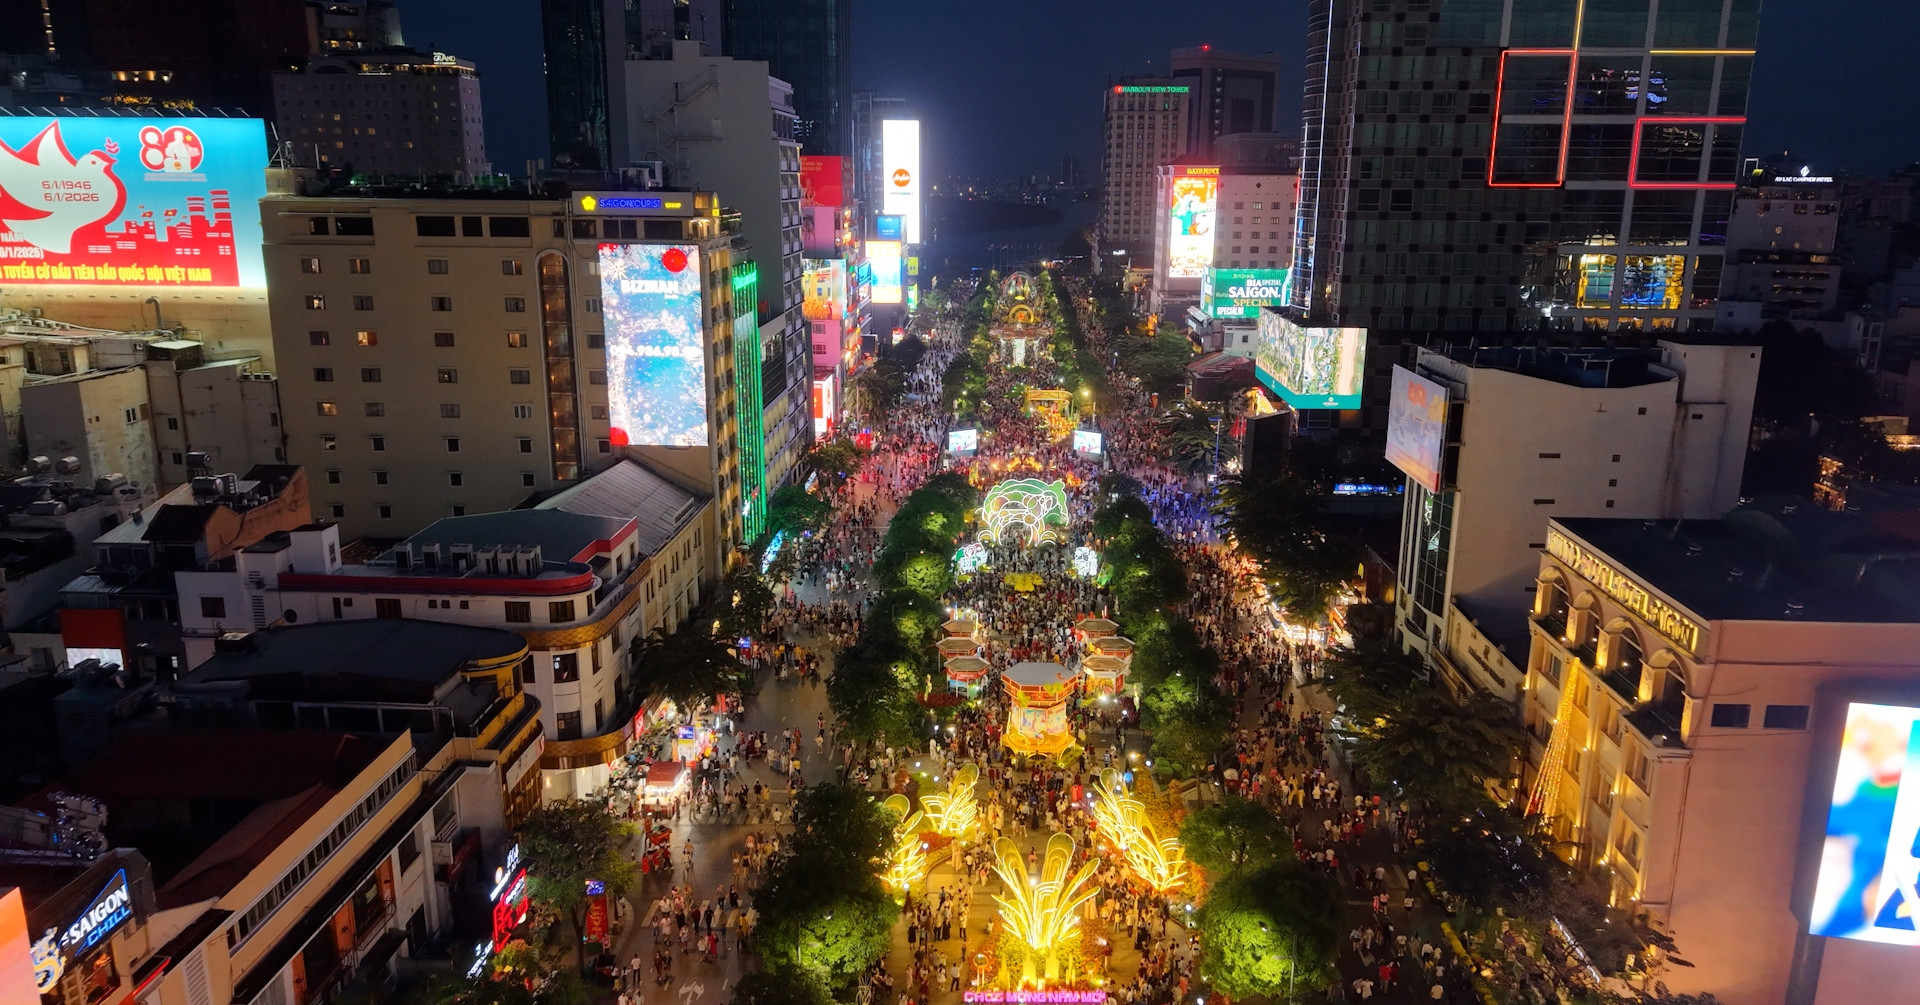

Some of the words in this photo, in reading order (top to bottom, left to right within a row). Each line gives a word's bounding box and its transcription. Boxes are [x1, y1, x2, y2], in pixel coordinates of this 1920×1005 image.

[42, 180, 92, 190] 6/1/1946
[44, 192, 100, 202] 6/1/2026
[1246, 279, 1262, 287] BIA
[68, 884, 129, 945] SAIGON
[85, 904, 131, 947] CHILL
